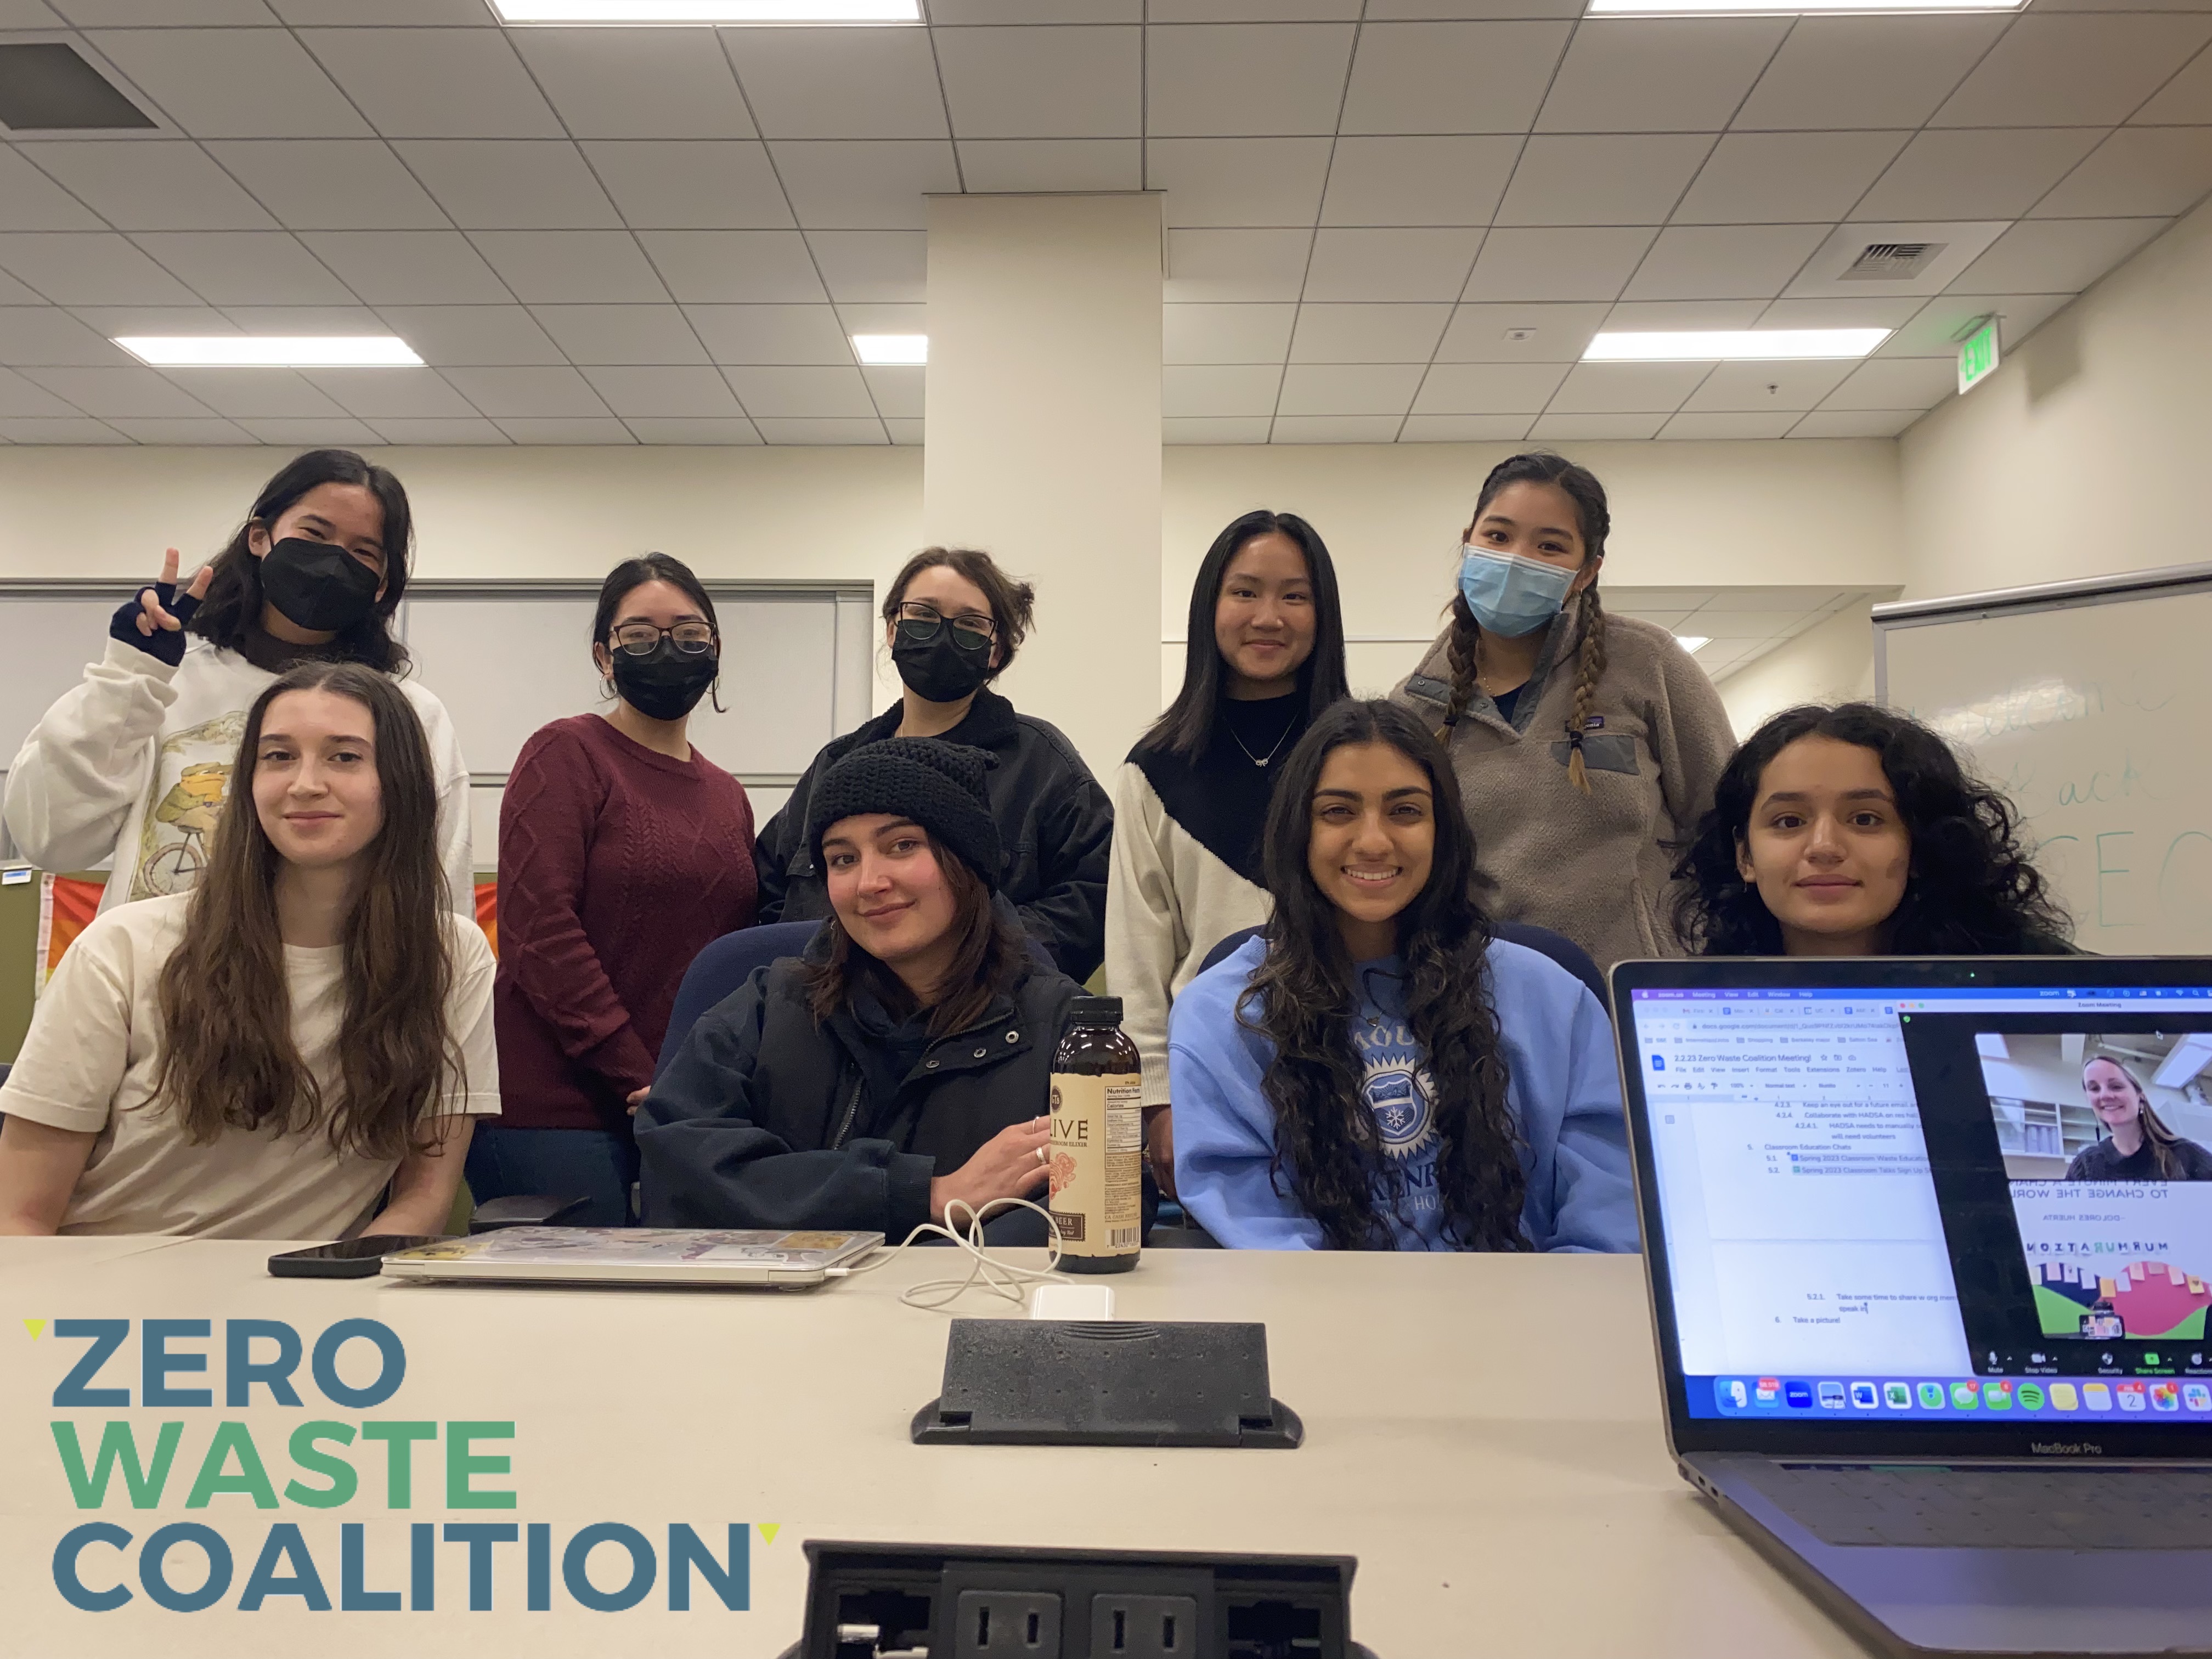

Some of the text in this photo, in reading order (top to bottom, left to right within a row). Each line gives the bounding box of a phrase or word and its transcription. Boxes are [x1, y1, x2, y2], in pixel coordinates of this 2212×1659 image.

[1965, 326, 1991, 381] EXIT
[1778, 1054, 1812, 1063] Meeting!
[2127, 1394, 2137, 1408] 2
[2031, 1442, 2102, 1454] MacBook Pro
